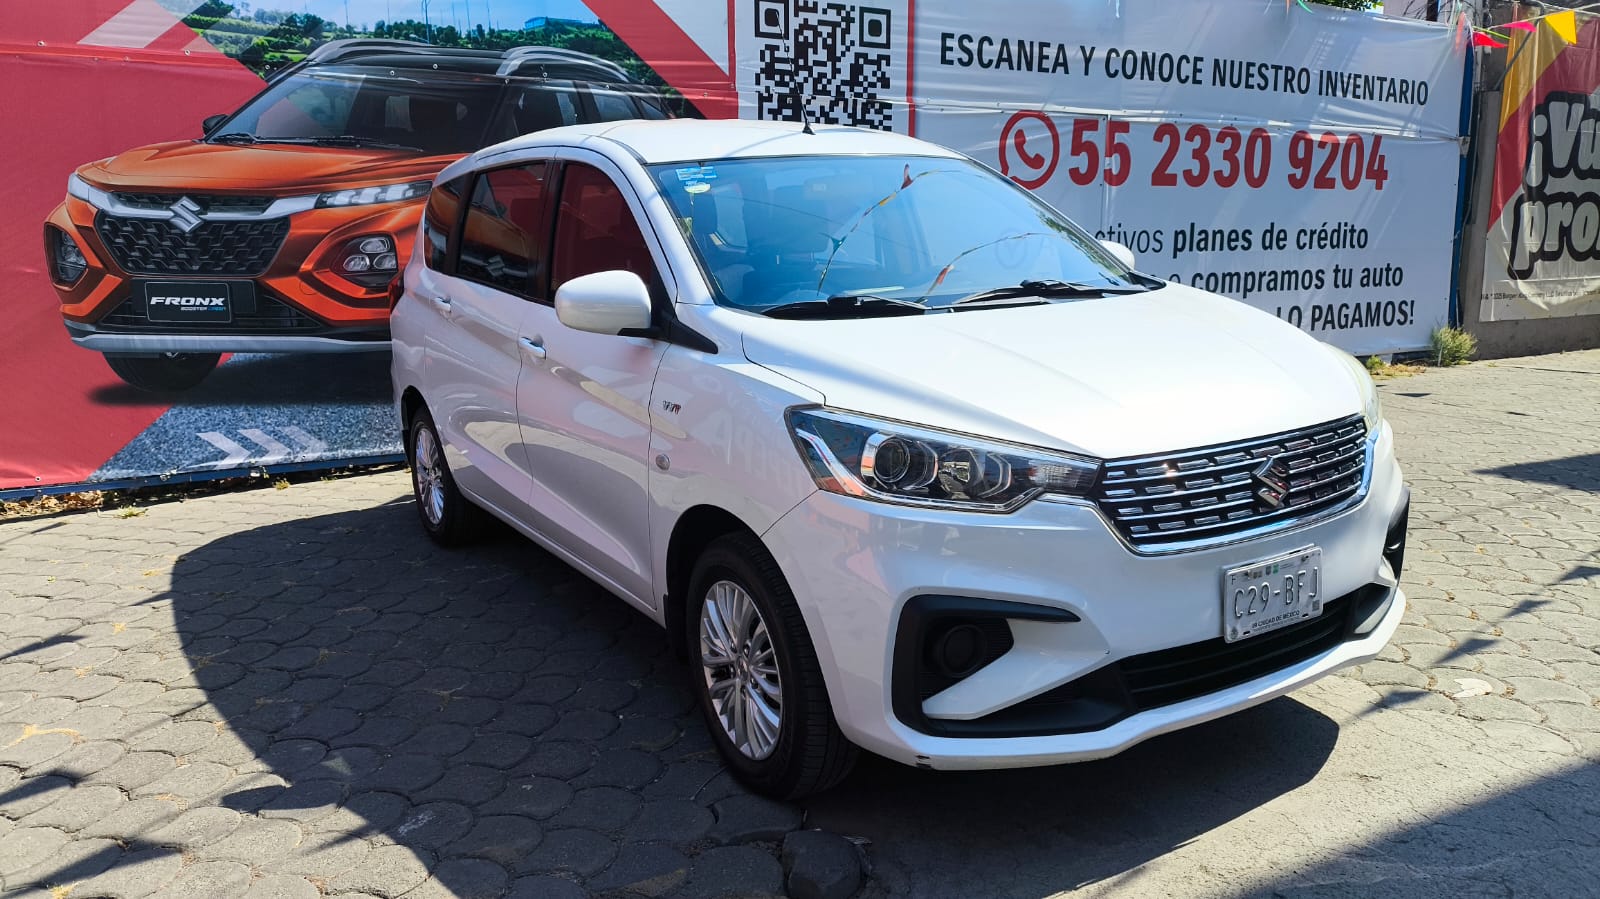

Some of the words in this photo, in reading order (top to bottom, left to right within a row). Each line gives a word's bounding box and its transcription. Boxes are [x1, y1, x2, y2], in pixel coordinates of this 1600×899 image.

[940, 32, 1070, 75] ESCANEA
[1079, 45, 1096, 76] Y
[1104, 47, 1204, 85] CONOCE
[1211, 58, 1311, 95] NUESTRO
[1318, 69, 1429, 106] INVENTARIO
[1068, 118, 1132, 187] 55
[1151, 122, 1272, 188] 2330
[1287, 129, 1389, 191] 9204
[1172, 222, 1253, 259] planes
[1261, 221, 1288, 251] de
[1296, 221, 1369, 250] crédito
[1510, 199, 1600, 273] pro
[150, 296, 225, 306] FRONX
[1191, 268, 1326, 299] compramos
[1333, 263, 1353, 289] tu
[1359, 262, 1404, 288] auto
[1310, 299, 1415, 332] PAGAMOS!
[1234, 566, 1319, 618] C29-BFJ
